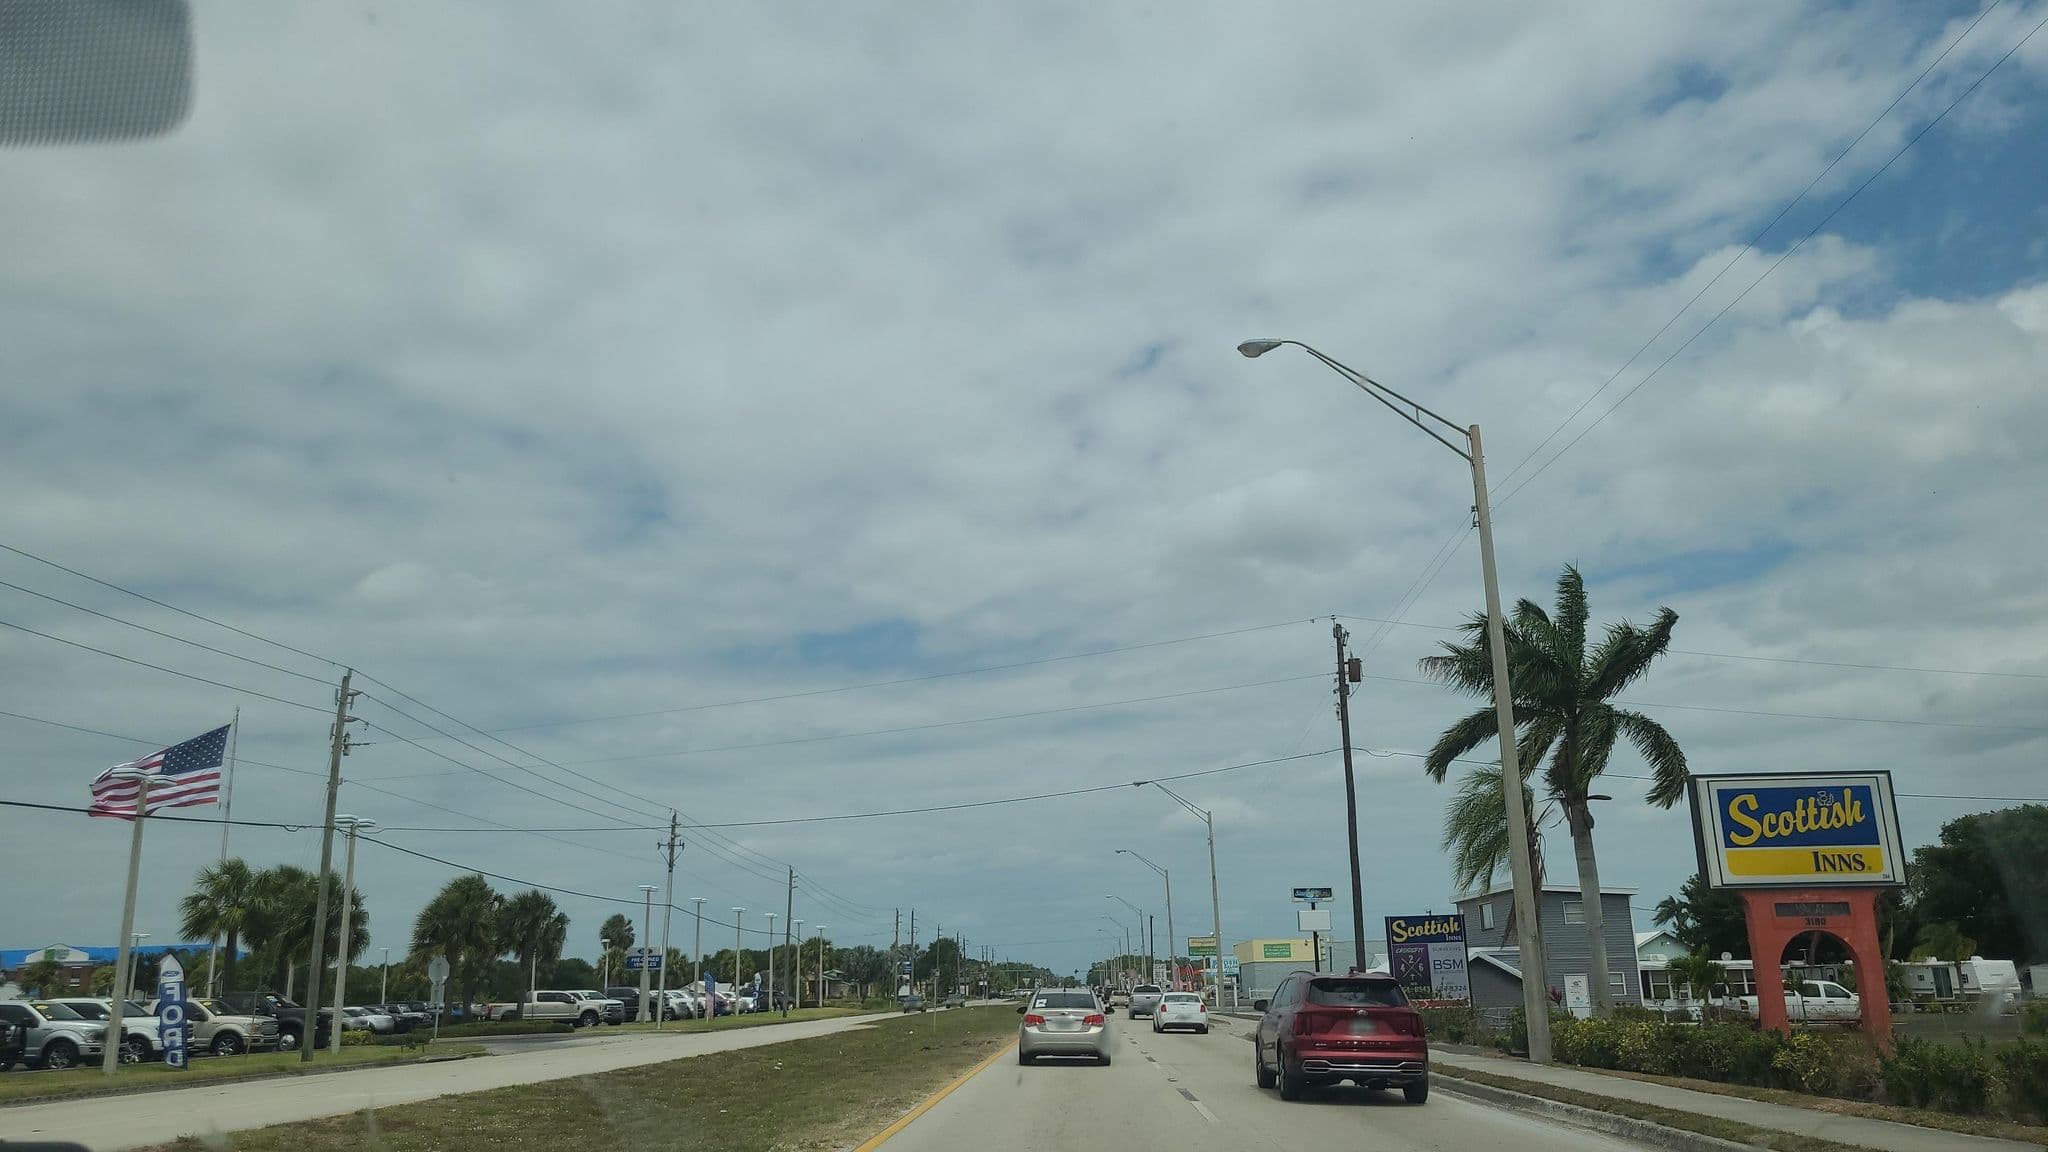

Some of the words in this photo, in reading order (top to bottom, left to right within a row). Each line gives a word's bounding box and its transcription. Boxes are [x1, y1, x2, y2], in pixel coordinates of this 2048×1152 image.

[1728, 788, 1866, 846] Scottish
[1811, 851, 1866, 872] INNS
[1391, 917, 1461, 943] Scottish
[1408, 955, 1414, 964] 2
[1433, 959, 1464, 969] BSM
[1400, 963, 1406, 972] 4
[1418, 963, 1424, 972] 6
